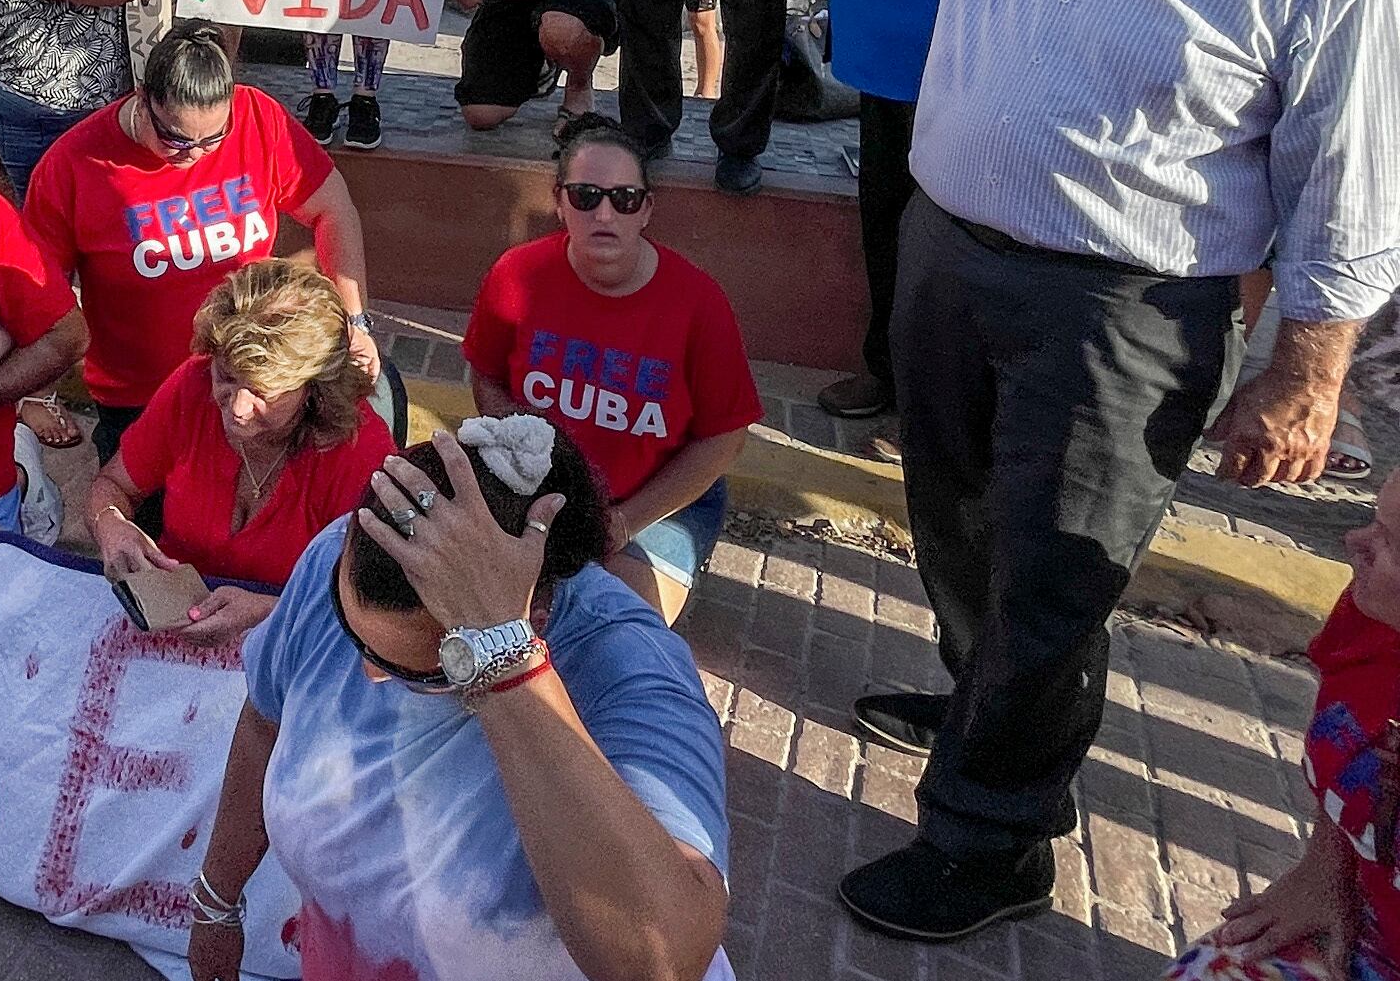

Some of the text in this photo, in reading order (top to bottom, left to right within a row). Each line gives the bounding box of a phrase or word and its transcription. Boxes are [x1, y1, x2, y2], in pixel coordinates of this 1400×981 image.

[125, 174, 260, 242] FREE
[133, 211, 269, 278] CUBA
[529, 330, 672, 401] FREE
[523, 371, 667, 438] CUBA
